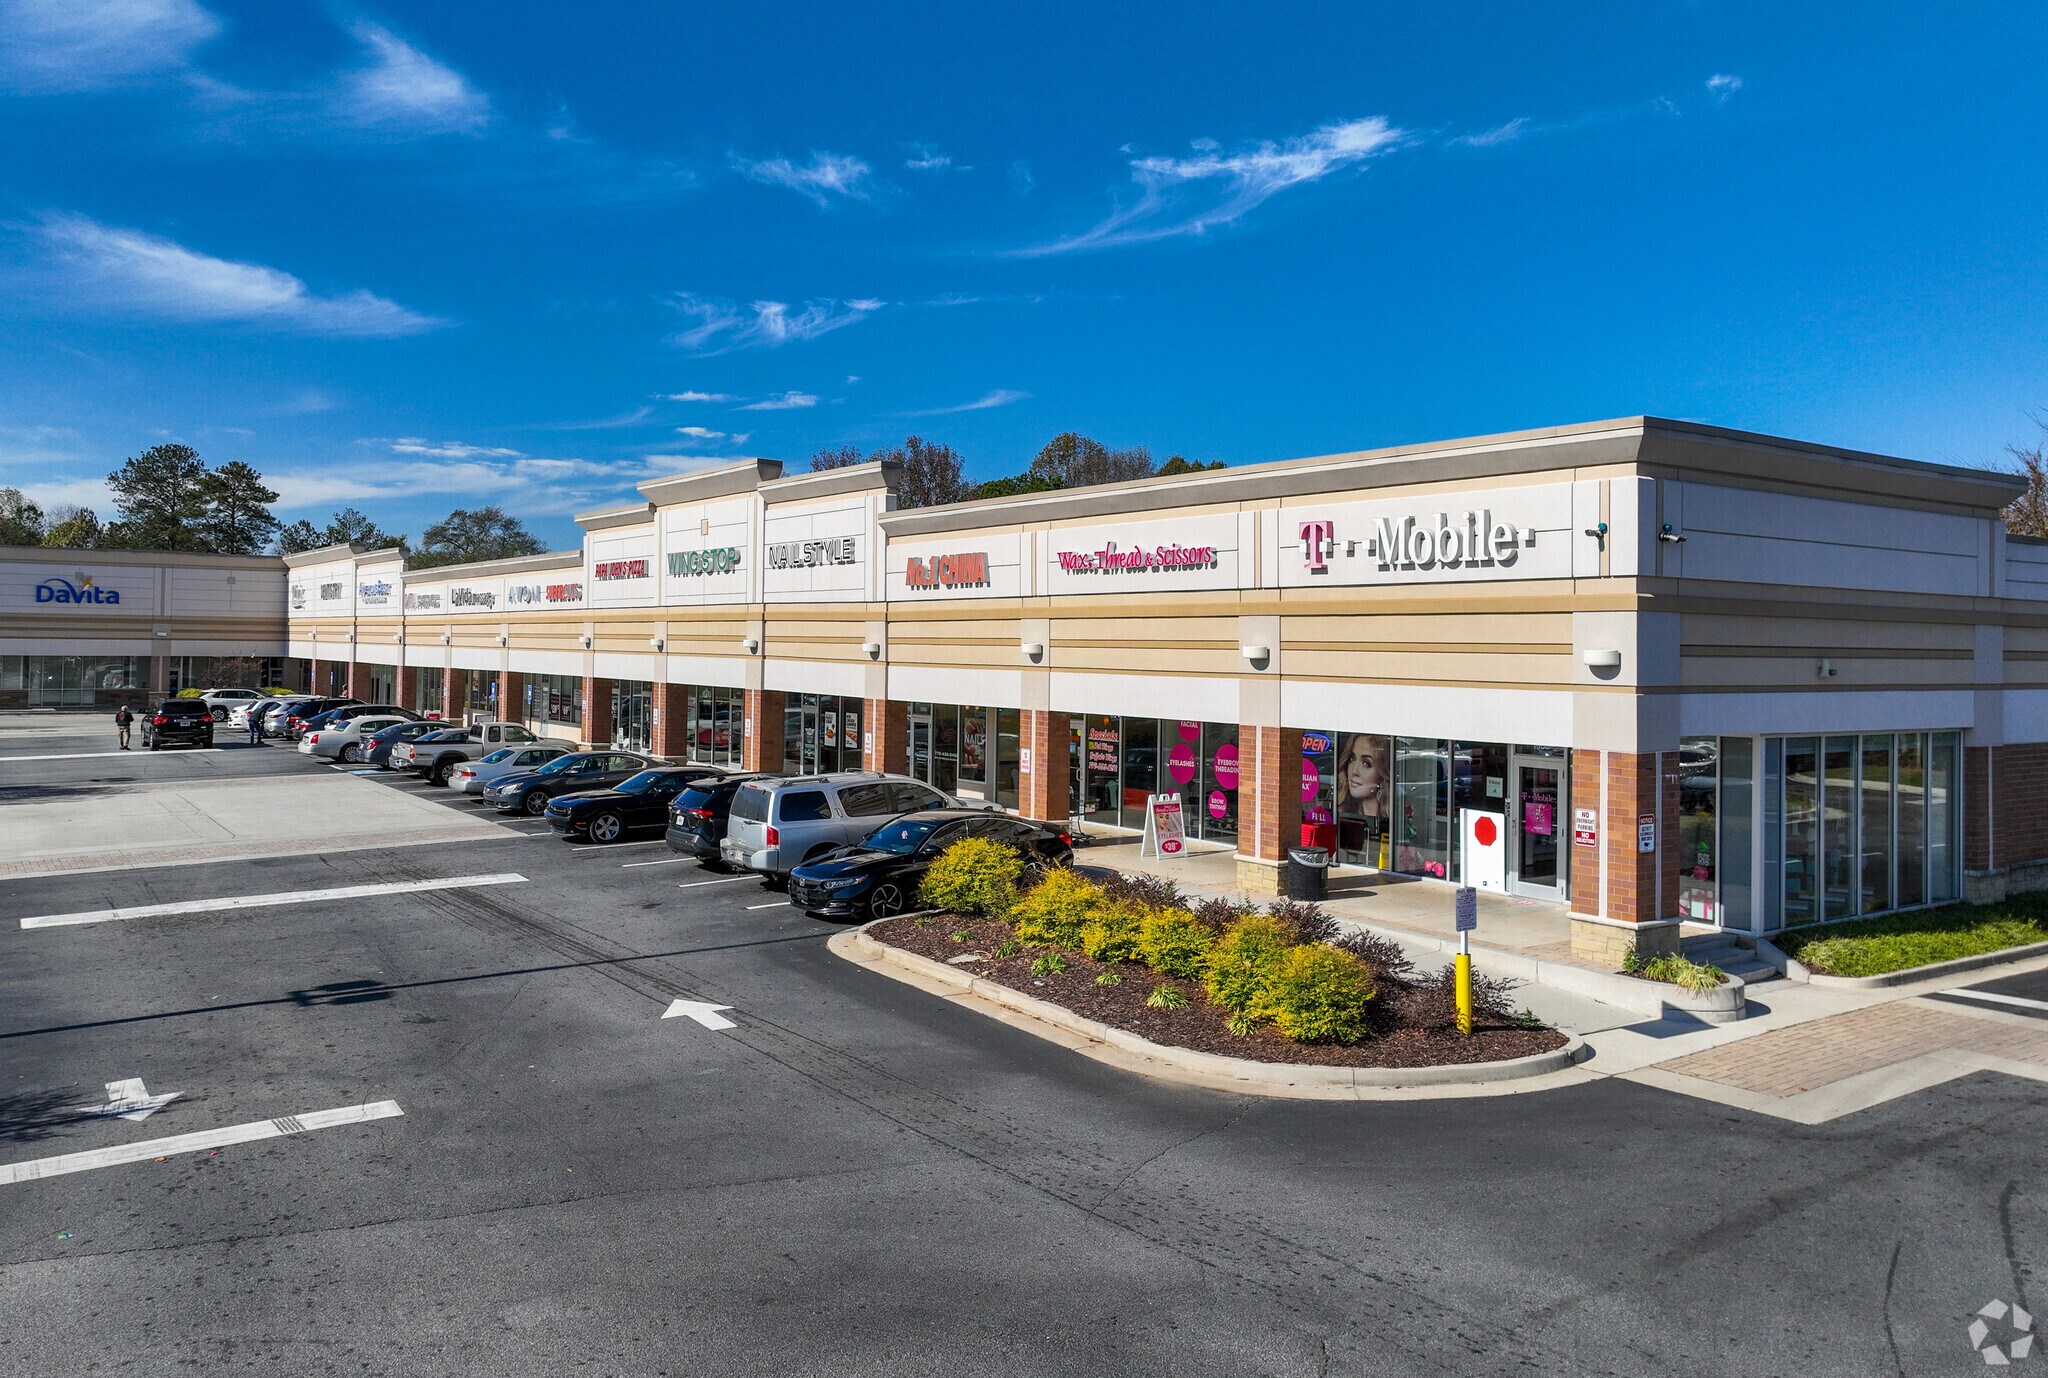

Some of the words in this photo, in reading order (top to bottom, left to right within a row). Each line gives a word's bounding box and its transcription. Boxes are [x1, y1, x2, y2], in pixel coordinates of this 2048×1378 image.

[1095, 541, 1143, 569] Thread
[1145, 552, 1153, 567] &
[1155, 543, 1212, 567] Scissors
[940, 552, 986, 584] CHINA
[36, 578, 120, 604] DaVita
[1302, 774, 1318, 782] ILIAN
[1301, 782, 1310, 790] AX
[1582, 811, 1590, 819] NO
[1577, 823, 1594, 832] PARKING
[1581, 831, 1590, 839] NO
